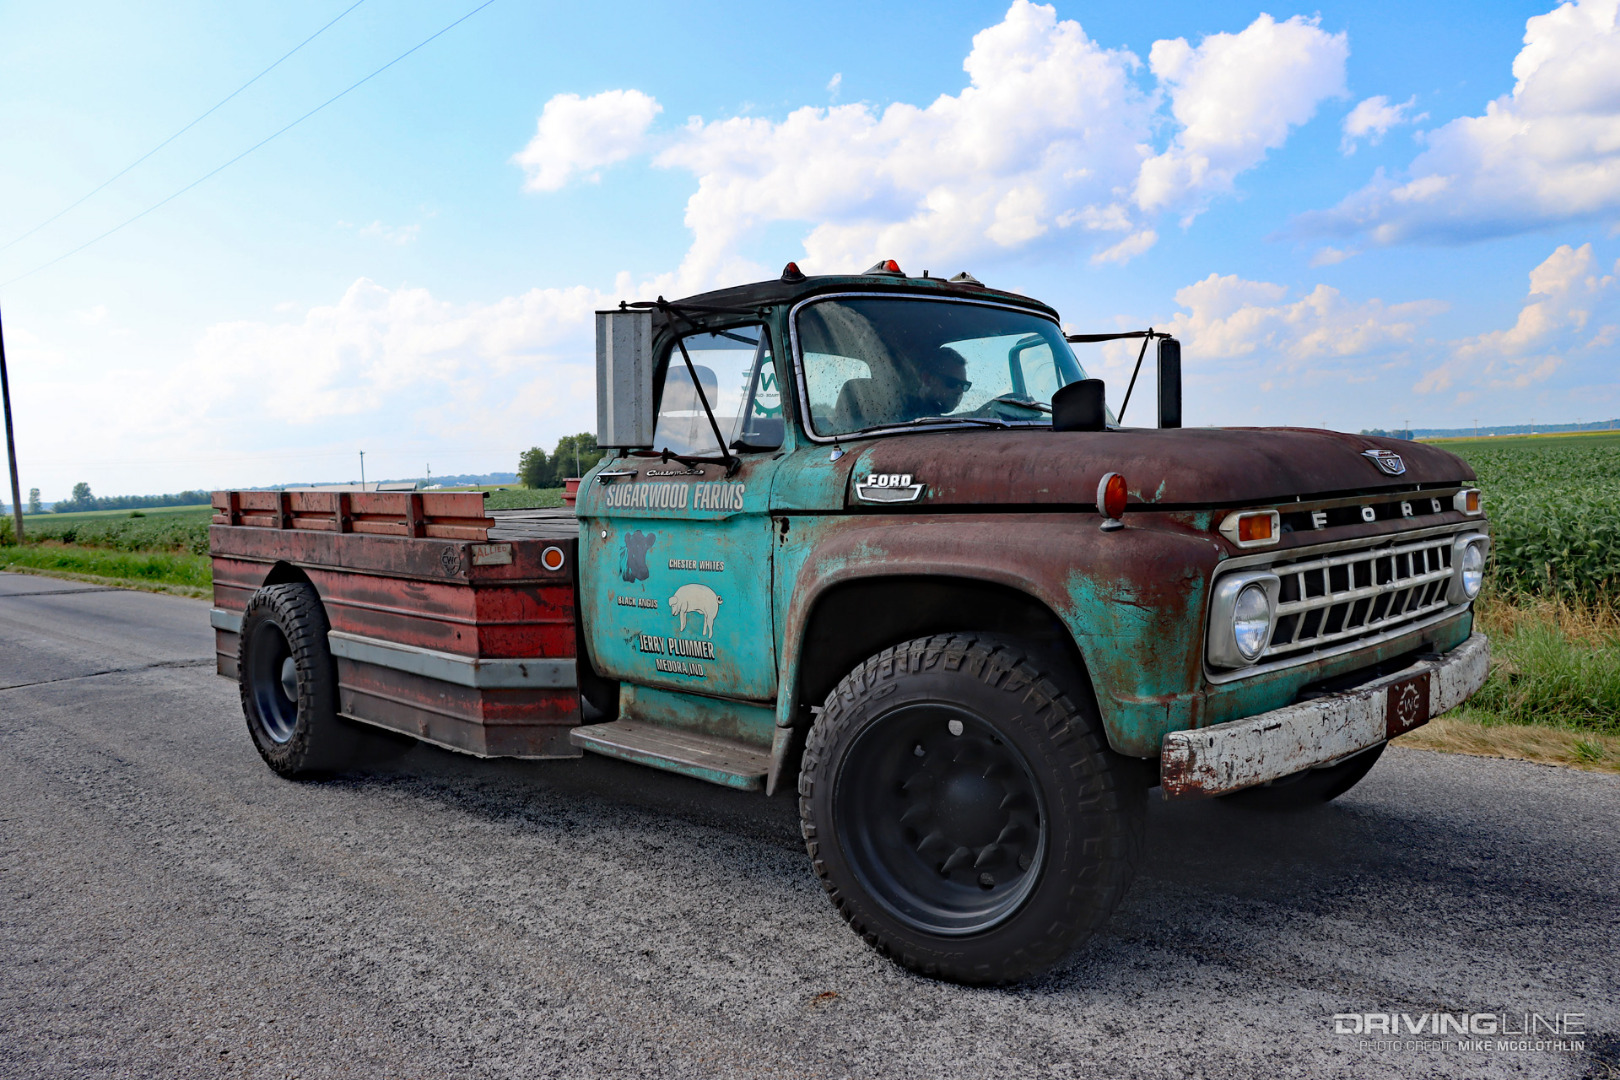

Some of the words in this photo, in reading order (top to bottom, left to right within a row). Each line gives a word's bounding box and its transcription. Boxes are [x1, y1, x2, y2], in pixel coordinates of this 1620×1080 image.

[867, 473, 912, 487] FORD
[606, 483, 689, 509] SUGARWOOD
[693, 483, 745, 511] FARMS
[1312, 497, 1442, 529] FORD
[475, 546, 507, 563] ALLIED
[668, 559, 697, 570] CHESTER
[699, 560, 725, 571] WHITES
[617, 596, 636, 606] BLACK
[638, 598, 658, 609] ANGUS
[640, 634, 665, 654] JERRY
[667, 637, 715, 660] PLUMMER
